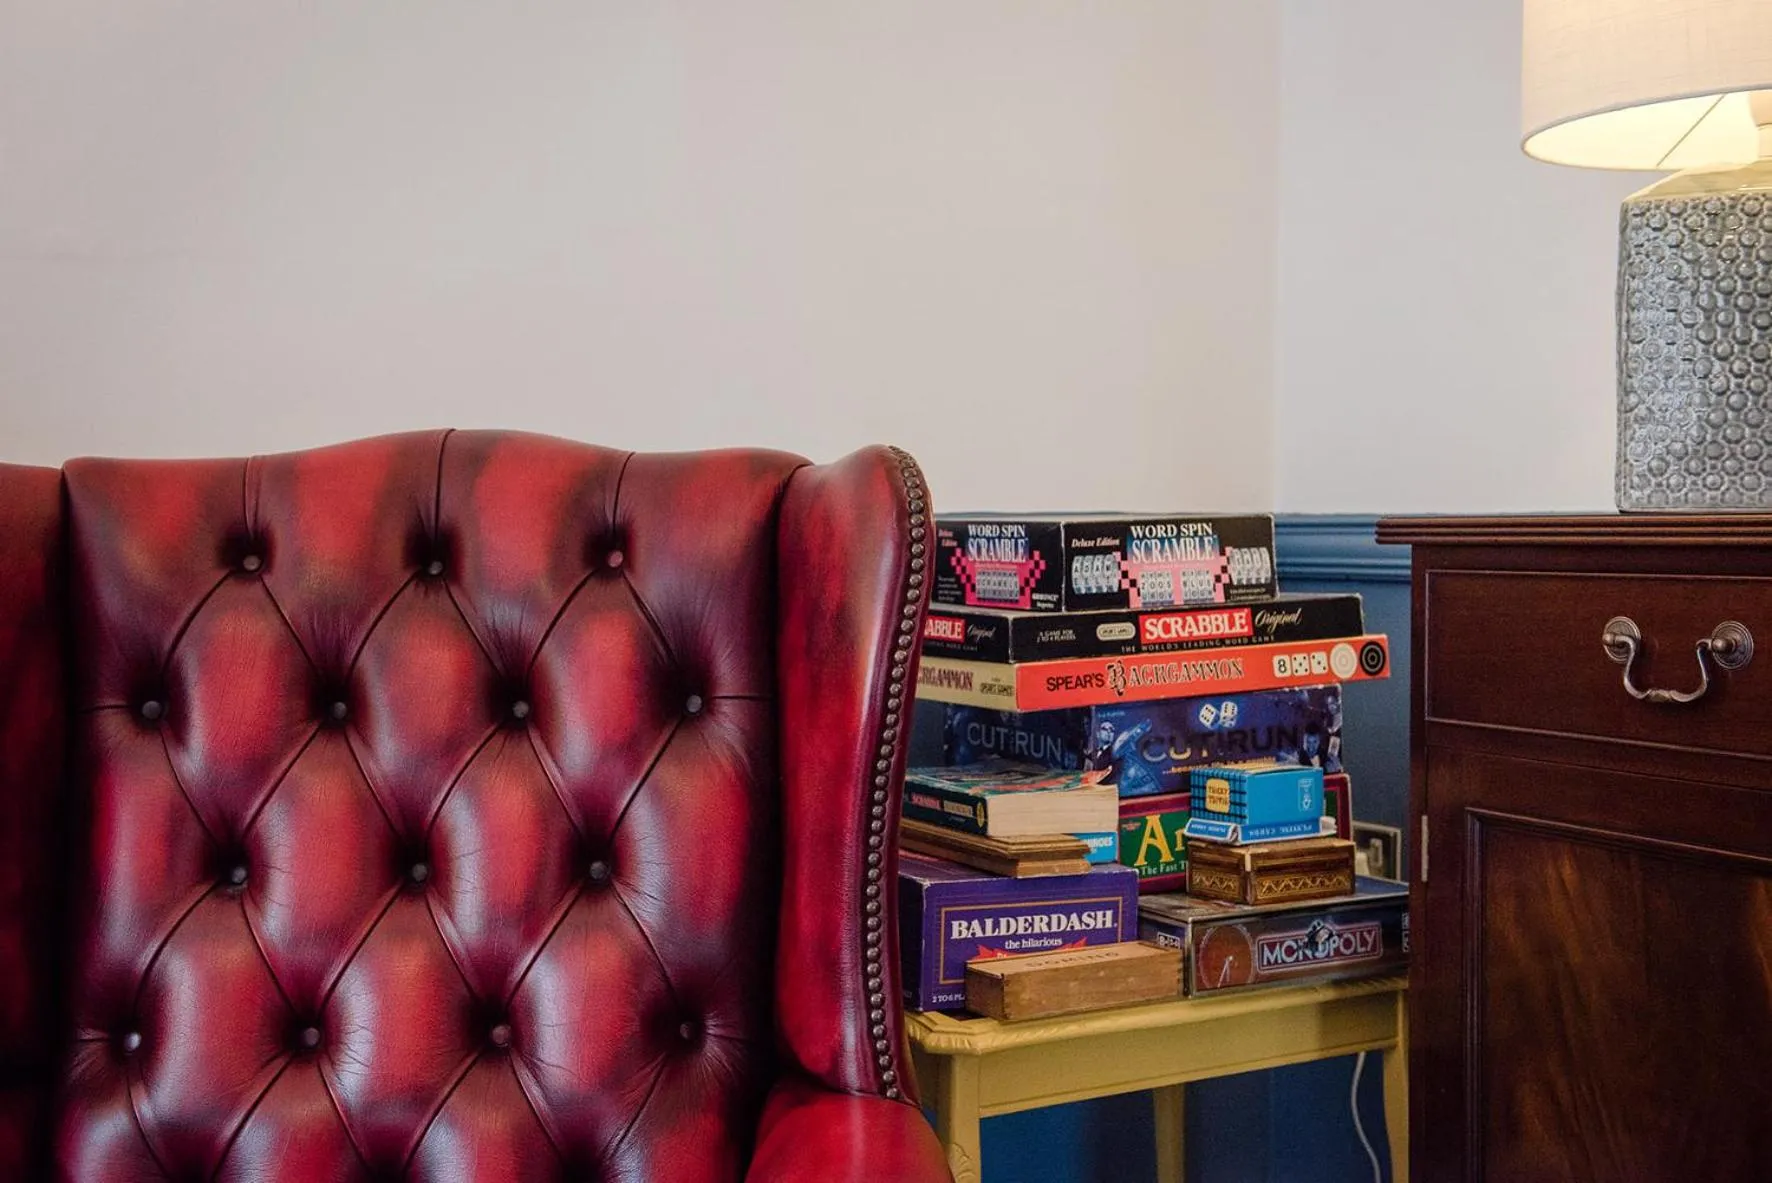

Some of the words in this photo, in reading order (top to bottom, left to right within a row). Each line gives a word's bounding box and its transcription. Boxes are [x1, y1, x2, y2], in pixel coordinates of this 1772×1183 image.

[968, 524, 1000, 538] WORD
[1001, 524, 1026, 538] SPIN
[1130, 524, 1177, 540] WORD
[1180, 522, 1213, 537] SPIN
[967, 538, 1027, 563] SCRAMBLE
[1132, 536, 1214, 564] SCRAMBLE
[1145, 608, 1248, 640] SCRABBLE
[1254, 608, 1302, 634] Original
[1121, 645, 1136, 653] THE
[1183, 639, 1221, 649] LEADING
[1225, 637, 1249, 646] WORD
[1252, 635, 1275, 643] GAME
[1046, 672, 1105, 692] SPEAR'S
[1107, 657, 1244, 697] BACKGAMMON
[967, 722, 1009, 751] CUT
[1014, 731, 1062, 762] RUN
[1142, 732, 1216, 762] CUT
[1229, 724, 1301, 753] RUN
[1160, 862, 1178, 873] Fast
[951, 910, 1114, 939] BALDERDASH
[1005, 939, 1020, 950] the
[1021, 937, 1063, 948] hilarious
